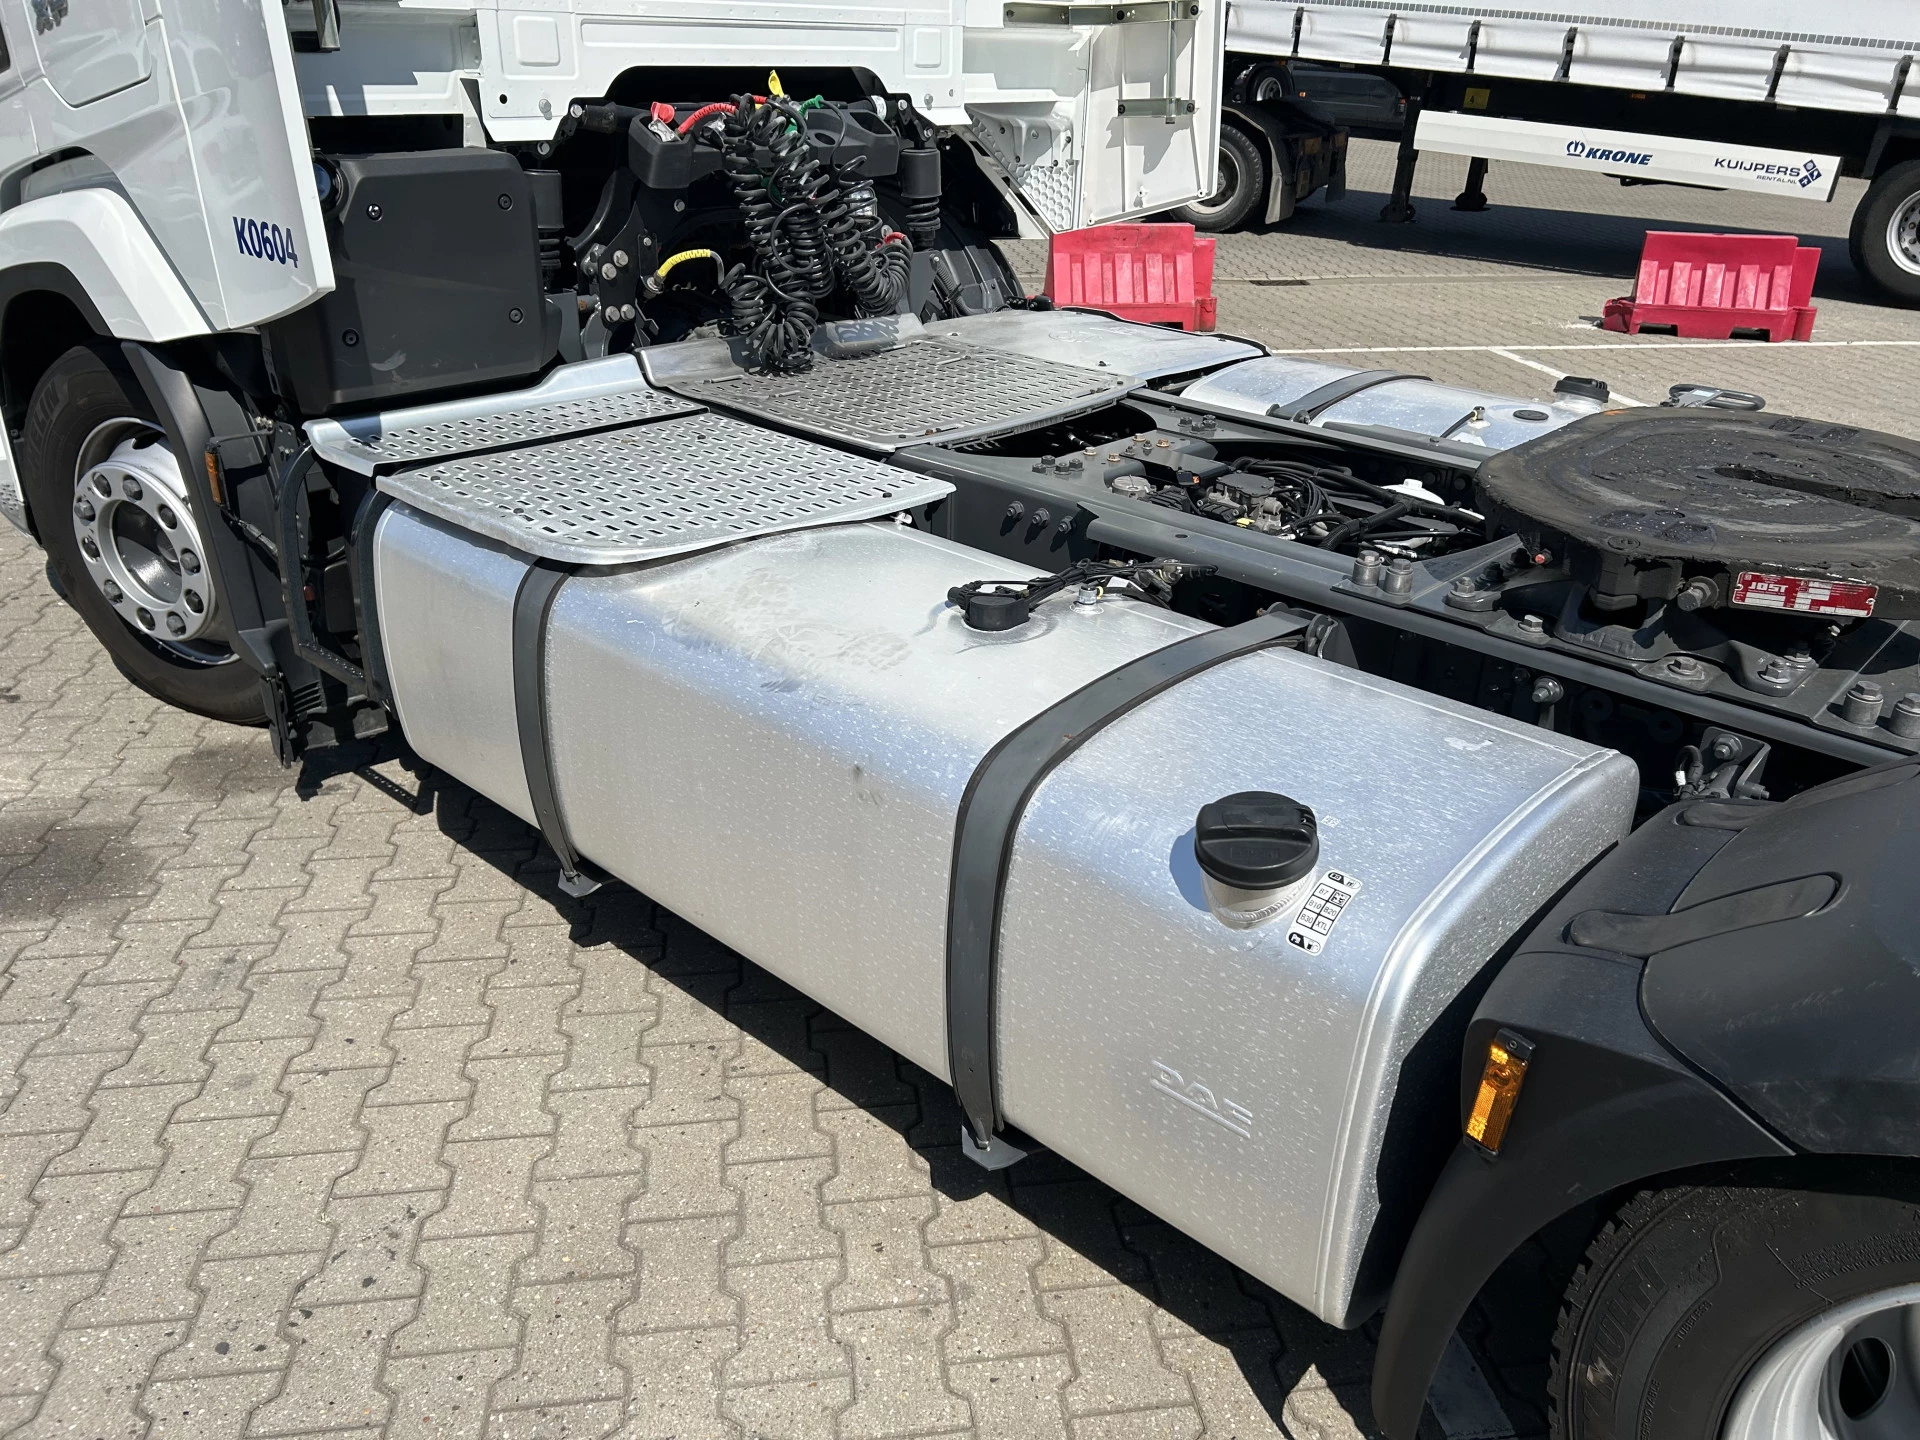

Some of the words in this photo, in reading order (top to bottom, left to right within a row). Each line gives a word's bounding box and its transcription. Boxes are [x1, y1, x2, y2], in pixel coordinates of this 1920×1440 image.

[1585, 147, 1653, 166] KRONE
[1714, 157, 1801, 177] KUIJPERS
[1756, 174, 1798, 185] RENTAL.NL
[232, 216, 299, 269] K0604
[1748, 581, 1789, 593] JOST
[1308, 899, 1322, 910] B10
[1323, 906, 1337, 917] B20
[1300, 913, 1314, 924] B30
[1316, 920, 1328, 931] XTL
